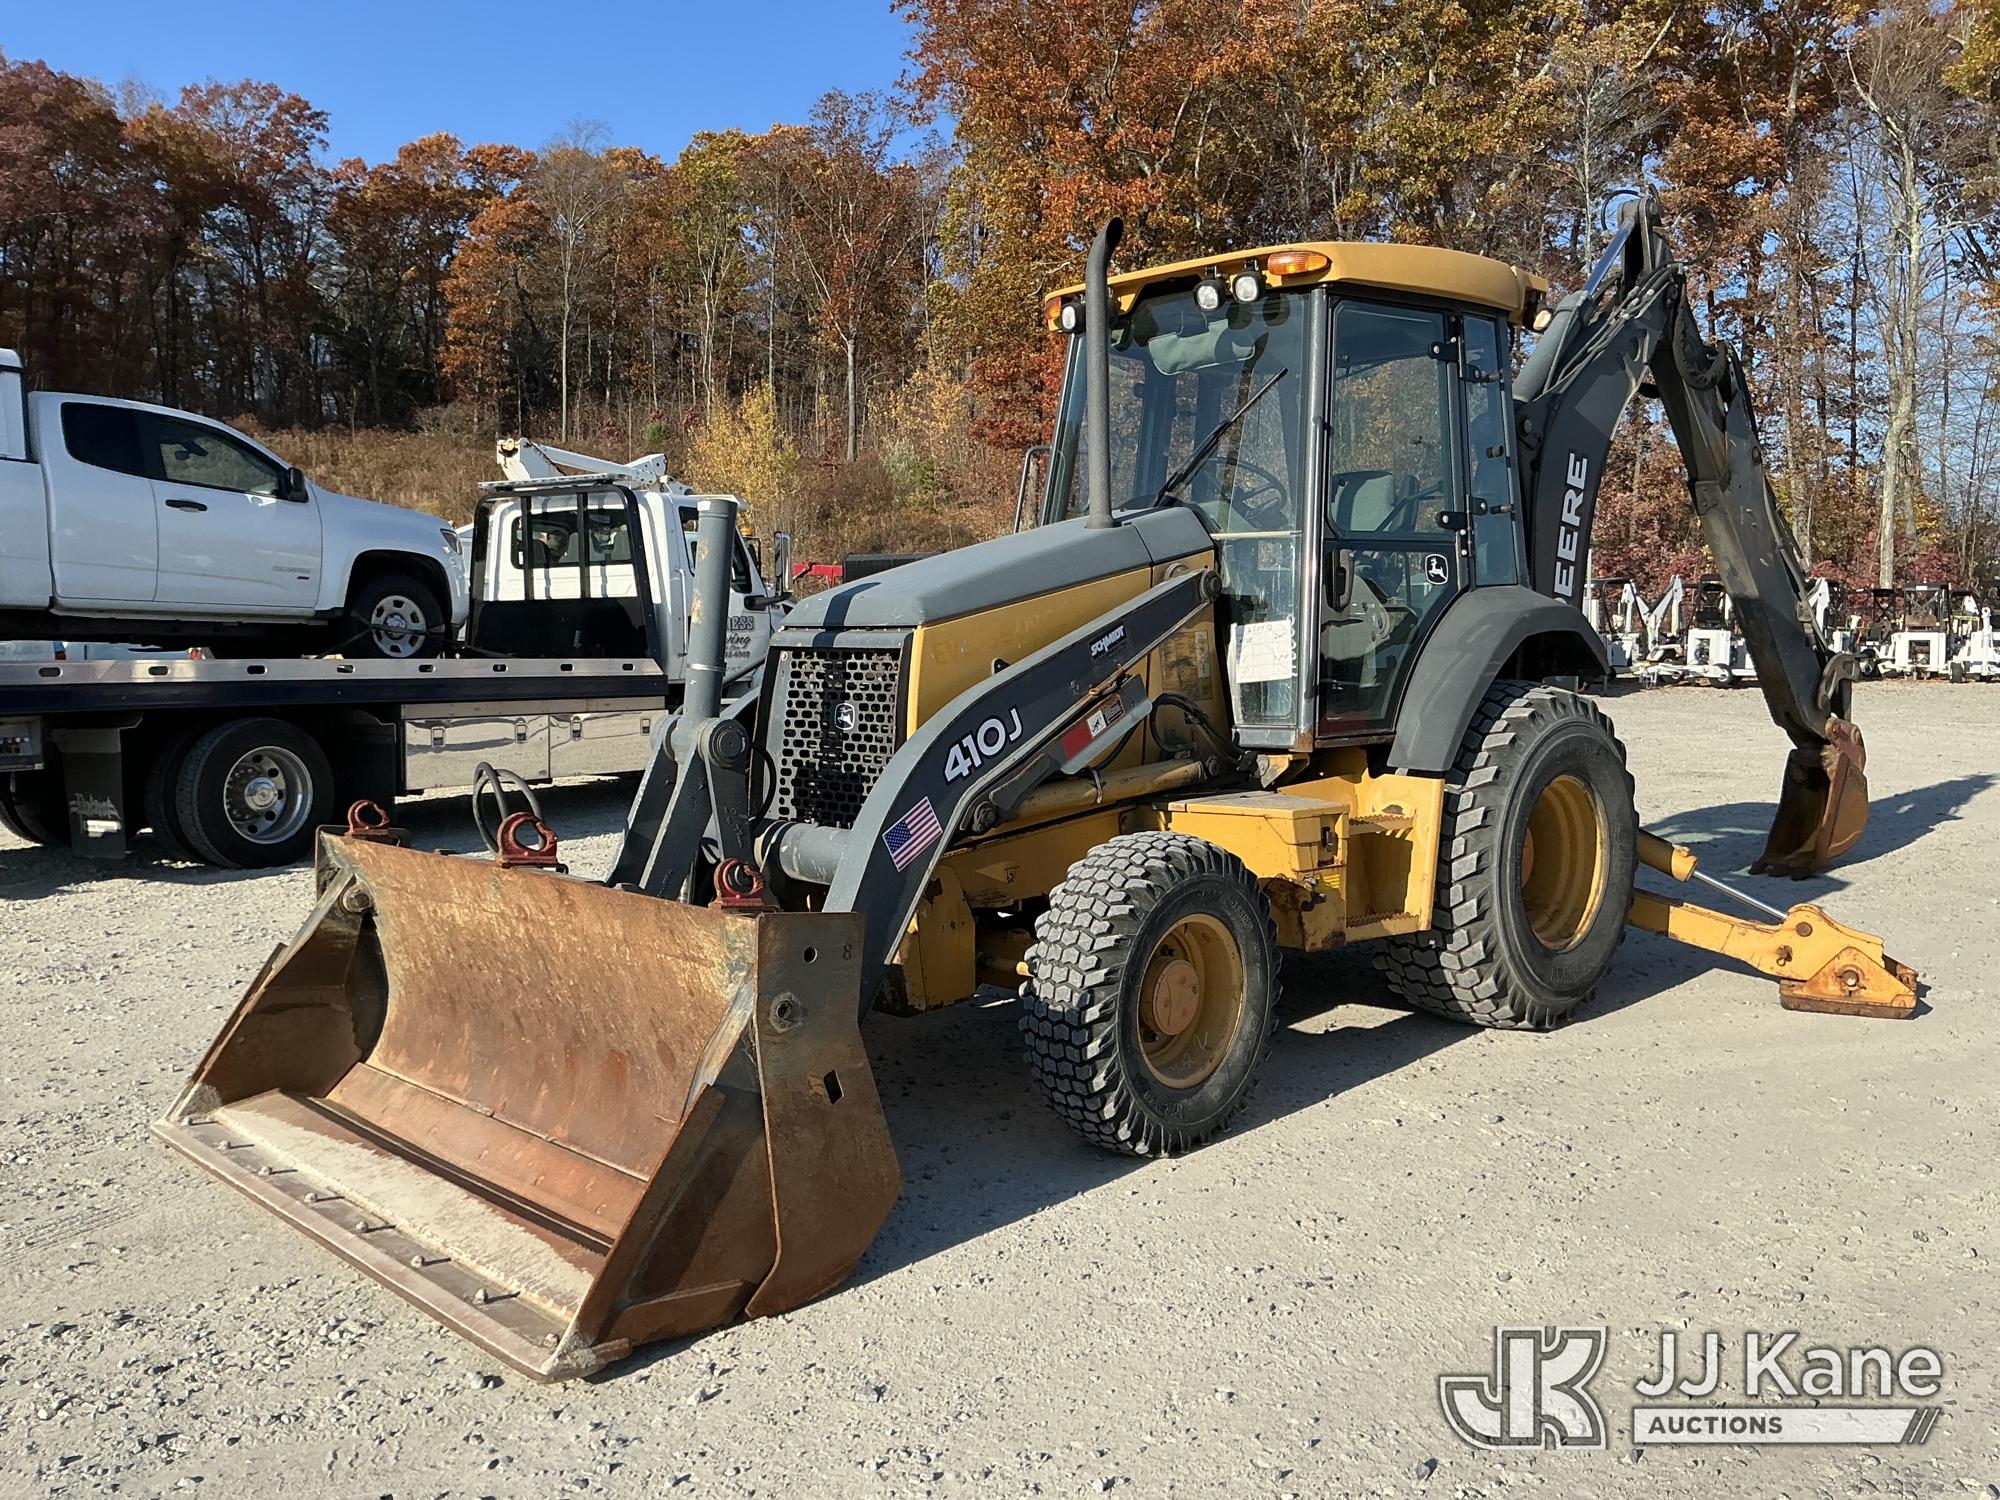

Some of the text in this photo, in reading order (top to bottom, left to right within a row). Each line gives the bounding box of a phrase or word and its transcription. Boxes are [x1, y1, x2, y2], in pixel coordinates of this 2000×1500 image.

[1554, 452, 1588, 604] EERE
[1090, 625, 1125, 656] SCHMIDT
[944, 707, 1022, 782] 410J
